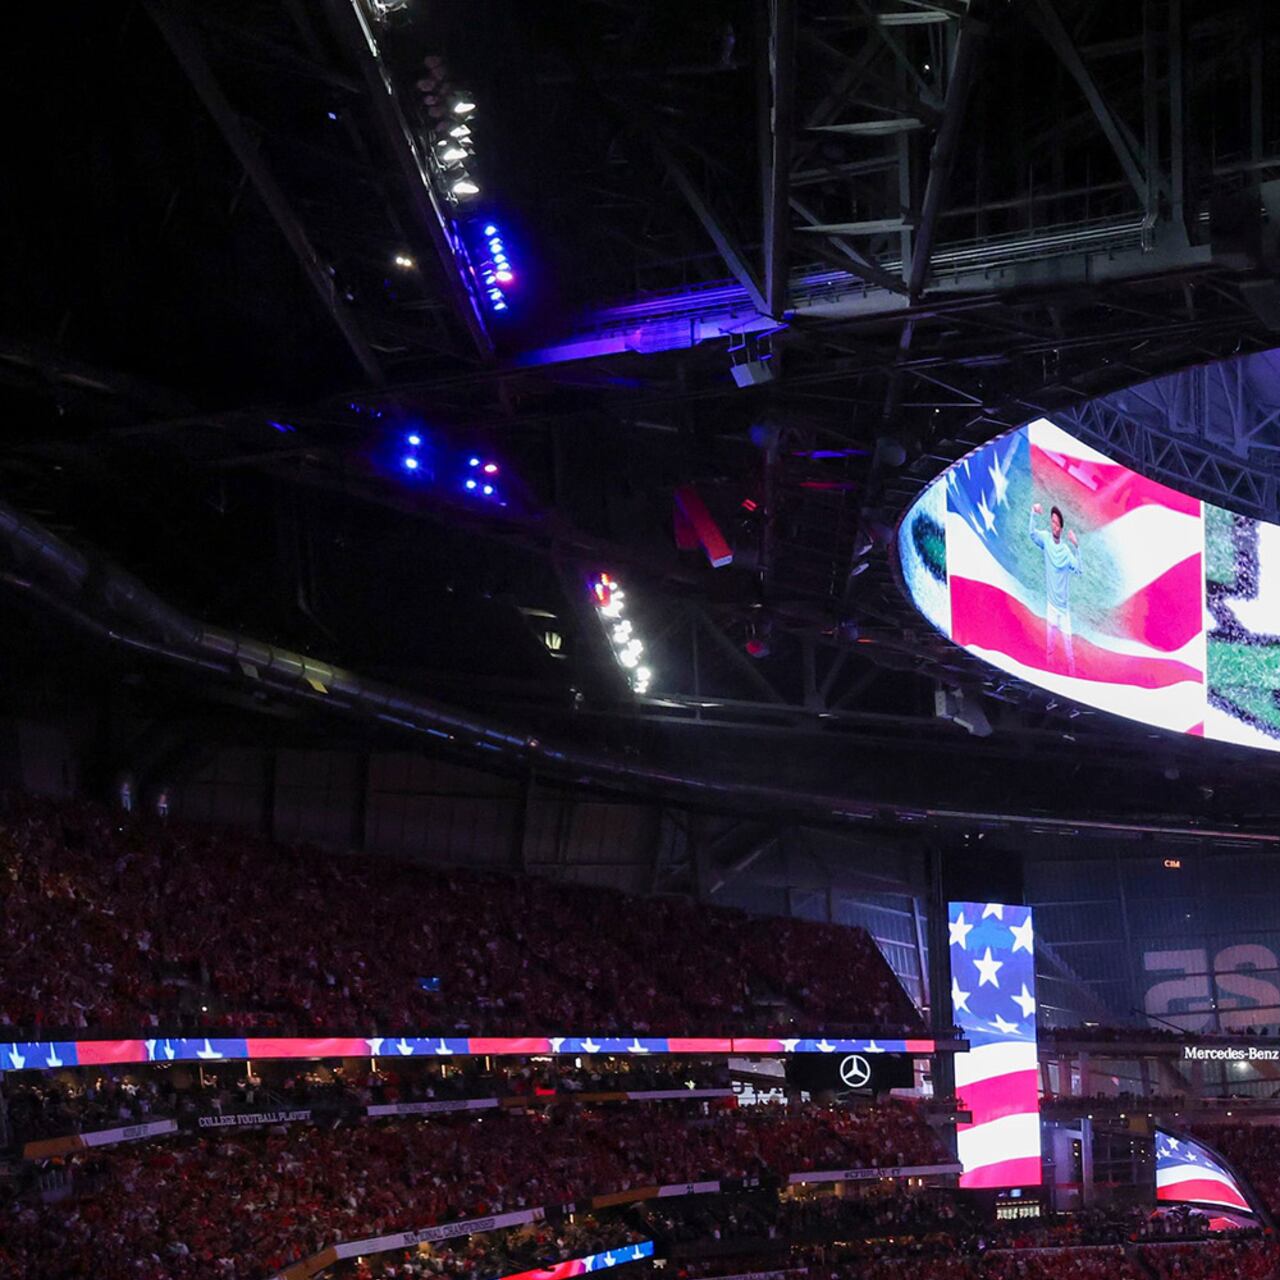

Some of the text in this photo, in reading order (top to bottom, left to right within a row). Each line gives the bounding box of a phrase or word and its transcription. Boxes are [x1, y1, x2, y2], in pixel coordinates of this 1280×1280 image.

[1184, 1047, 1279, 1061] Mercedes-Benz
[198, 1110, 312, 1128] COLLEGE FOOTBALL PLAYOFF
